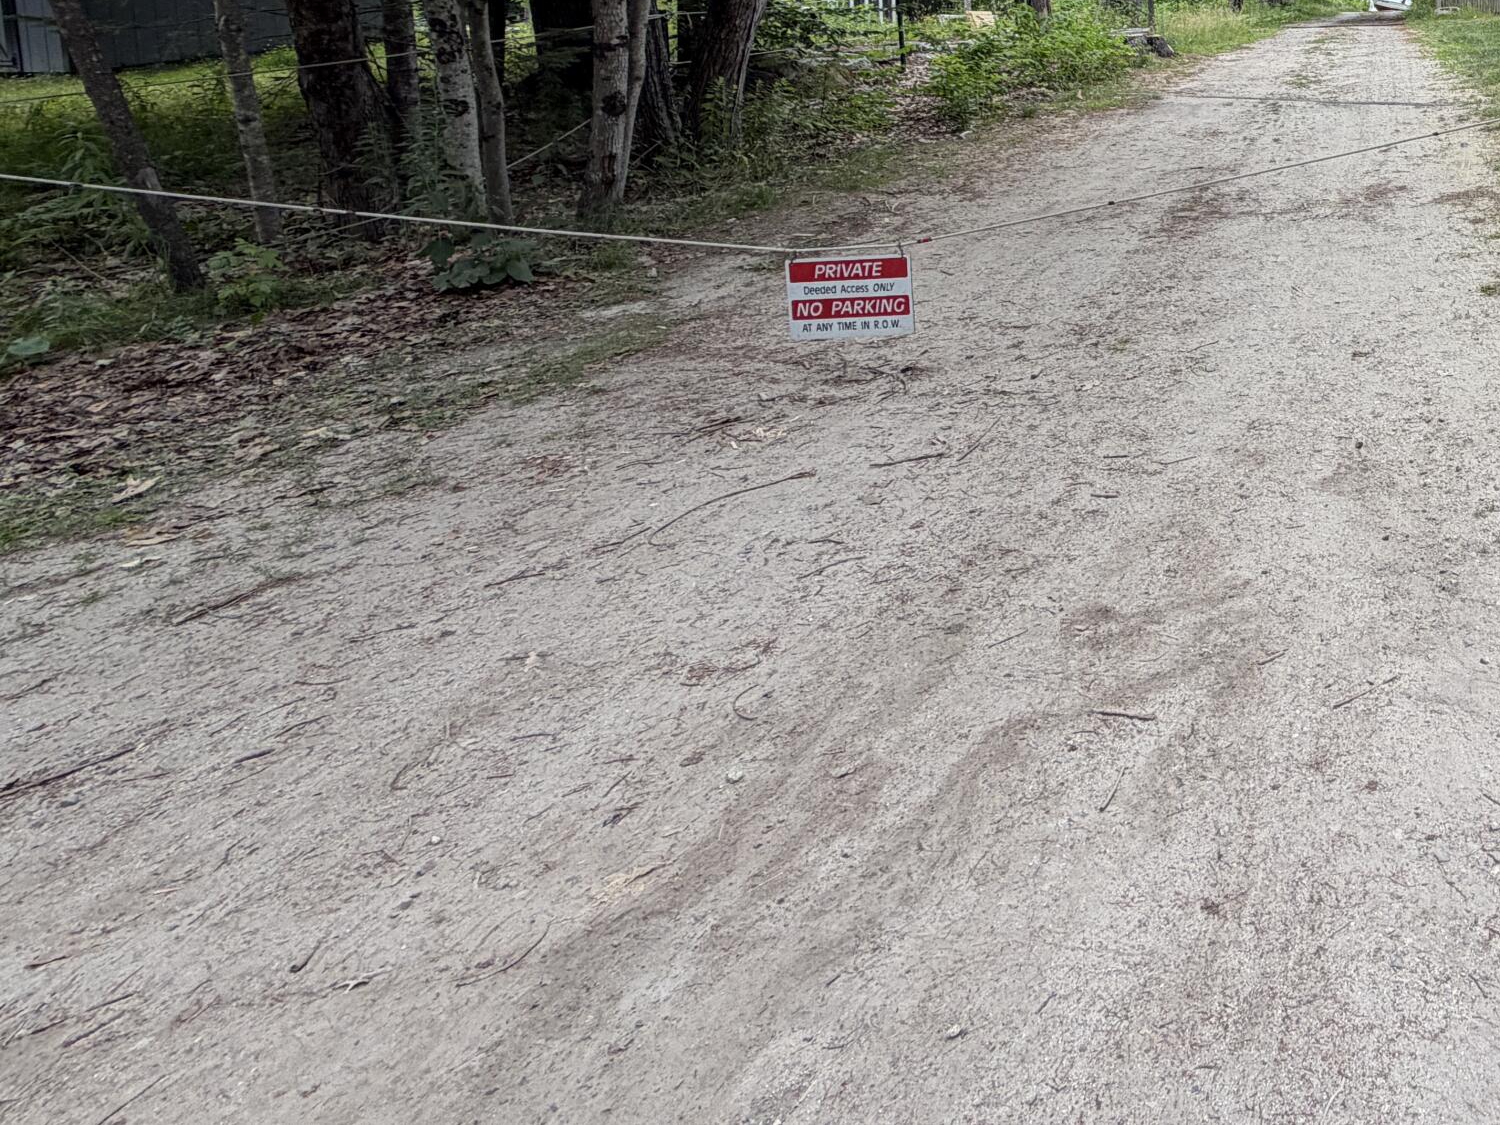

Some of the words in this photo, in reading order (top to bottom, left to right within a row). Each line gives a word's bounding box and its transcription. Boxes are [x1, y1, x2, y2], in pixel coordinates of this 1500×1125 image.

[814, 262, 882, 279] PRIVATE
[803, 286, 837, 295] Deeded
[840, 284, 869, 293] Access
[873, 282, 895, 292] ONLY
[797, 303, 823, 317] NO
[831, 298, 906, 315] PARKING
[802, 323, 812, 332] AT
[816, 322, 834, 331] ANY
[837, 321, 857, 331] TIME
[861, 320, 870, 329] IN
